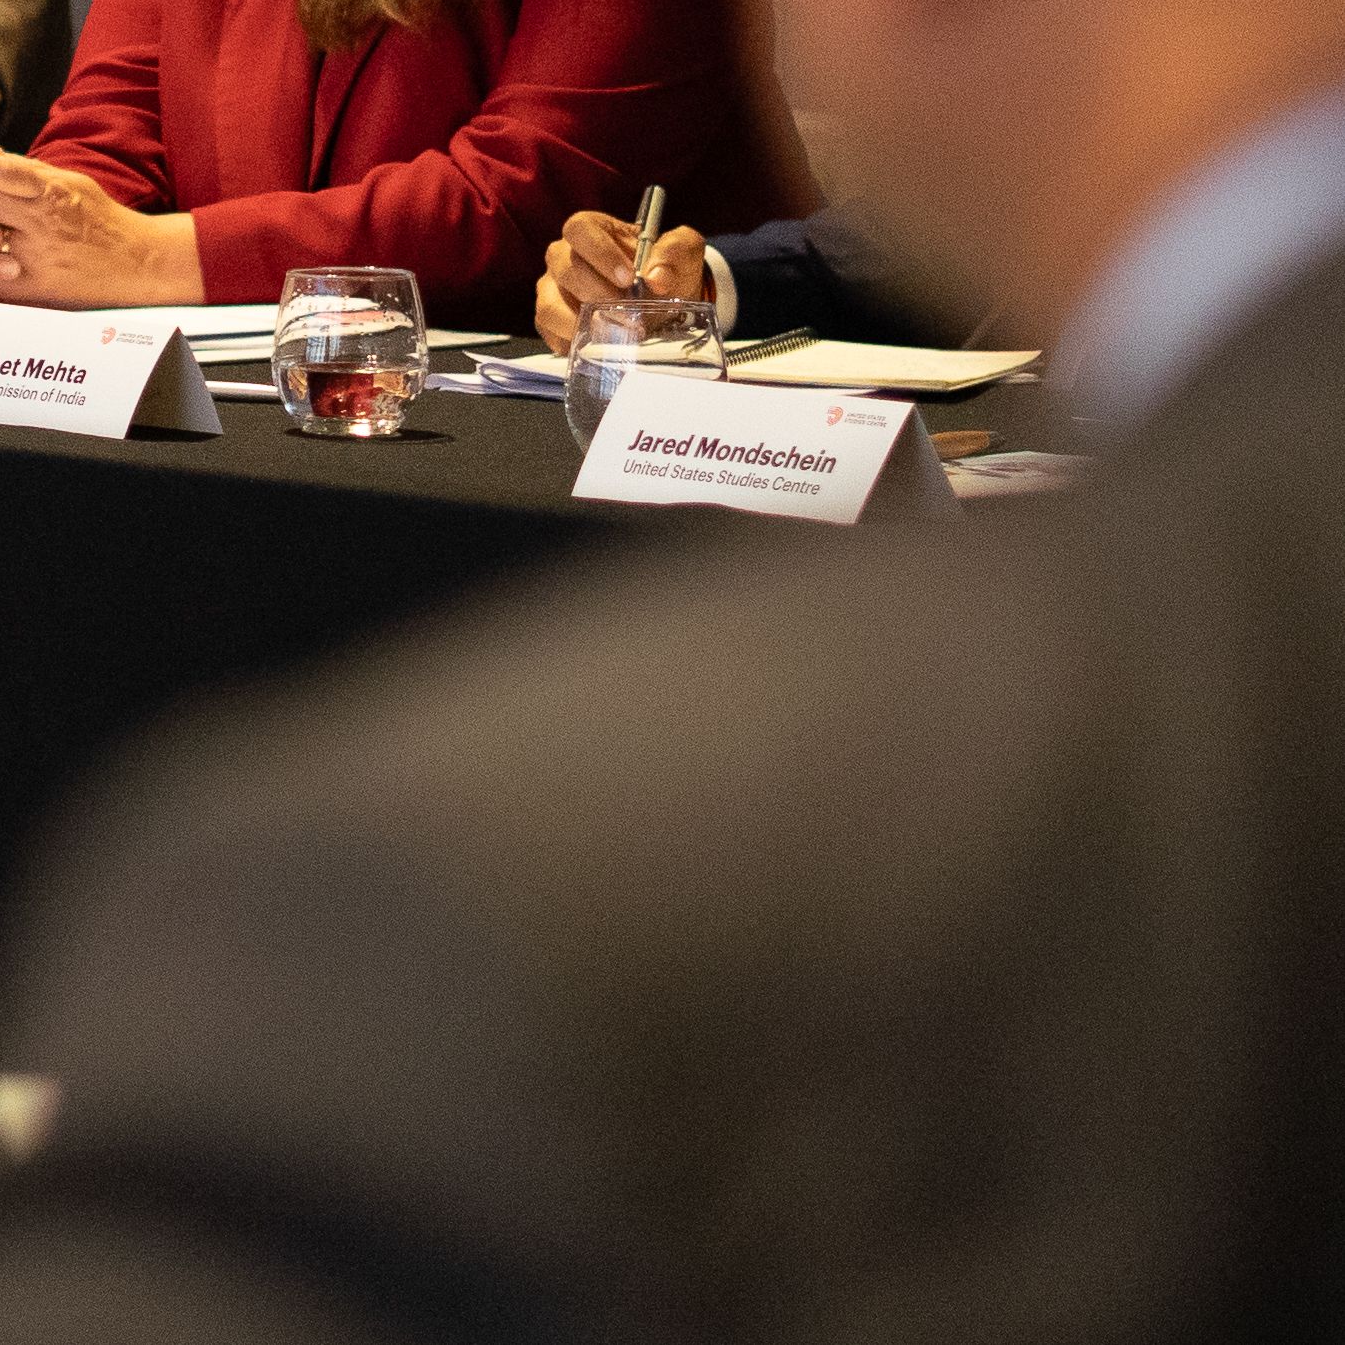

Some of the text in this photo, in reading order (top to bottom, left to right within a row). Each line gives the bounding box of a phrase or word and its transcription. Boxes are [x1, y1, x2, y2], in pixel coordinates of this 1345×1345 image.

[22, 357, 87, 385] Mehta
[40, 388, 56, 403] of
[55, 389, 87, 406] India
[627, 429, 837, 474] Jared Mondschein
[623, 458, 821, 495] United States Studies Centre
